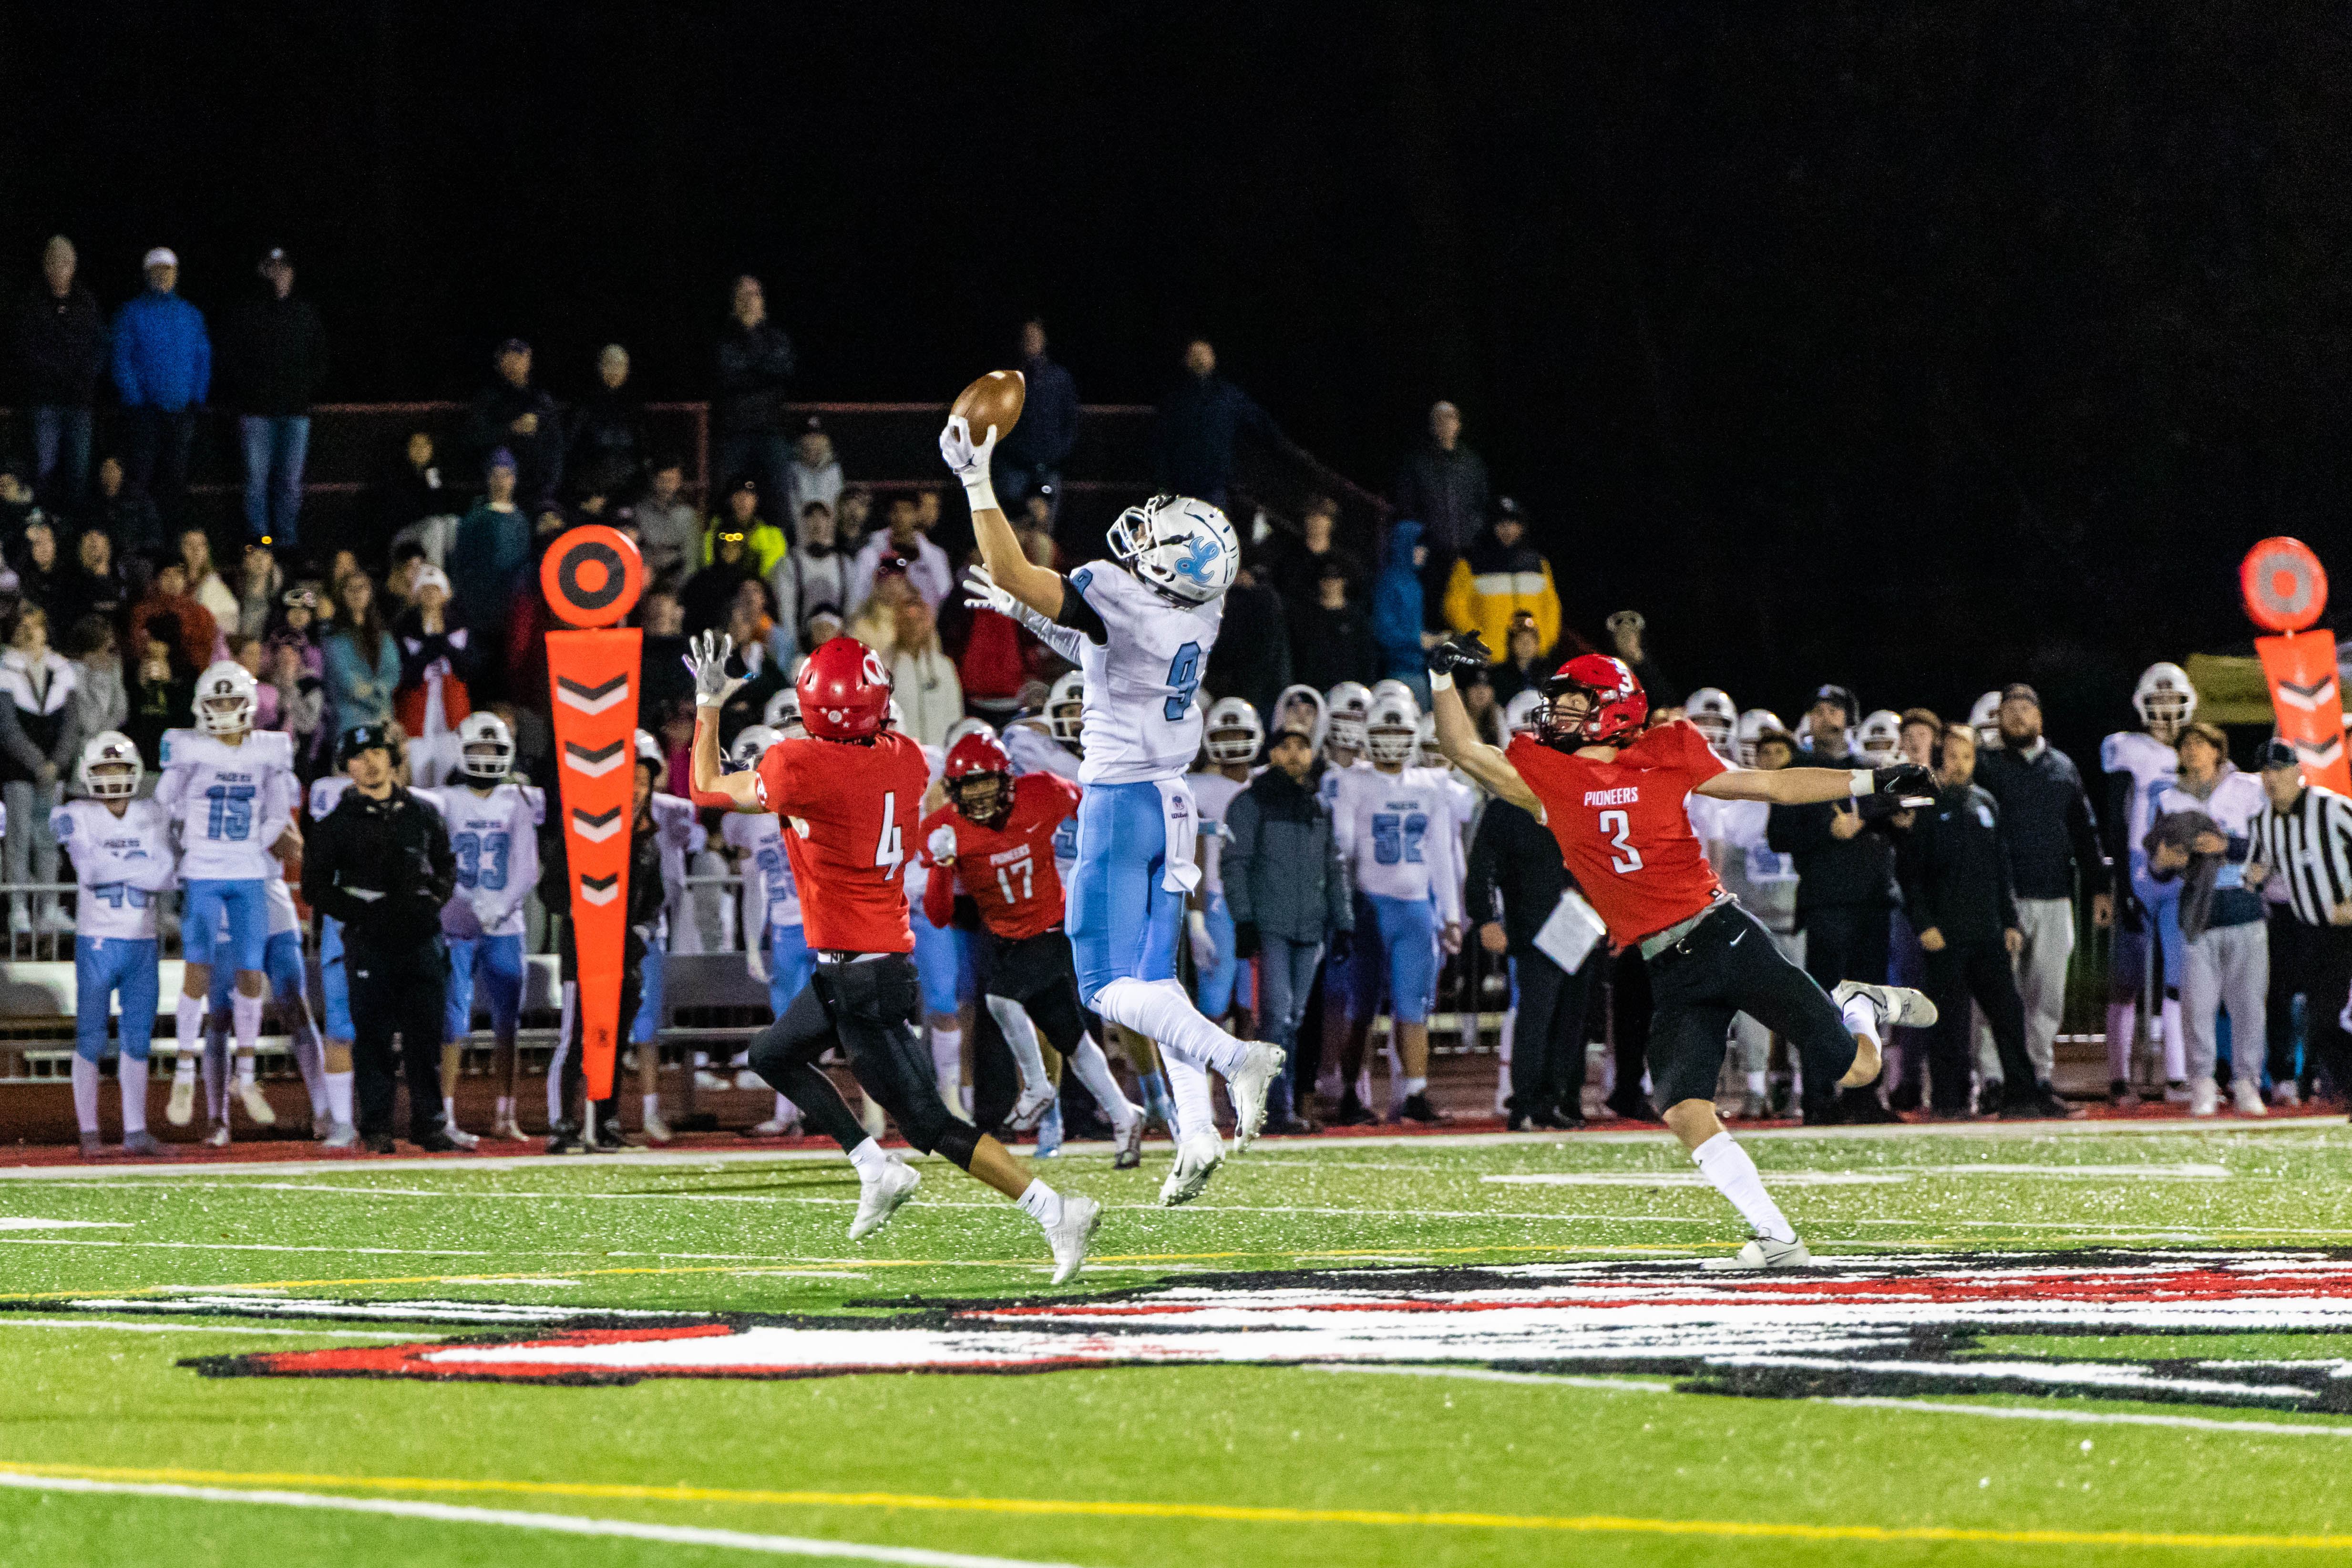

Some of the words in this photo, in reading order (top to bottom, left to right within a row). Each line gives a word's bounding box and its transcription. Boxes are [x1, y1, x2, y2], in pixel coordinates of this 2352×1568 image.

[1163, 640, 1202, 722] 9
[205, 785, 256, 841] 15
[1584, 786, 1638, 807] PIONEERS
[451, 831, 512, 891] 33
[874, 790, 905, 881] 4
[1371, 812, 1428, 866] 52
[1599, 810, 1643, 874] 3
[996, 857, 1033, 904] 17
